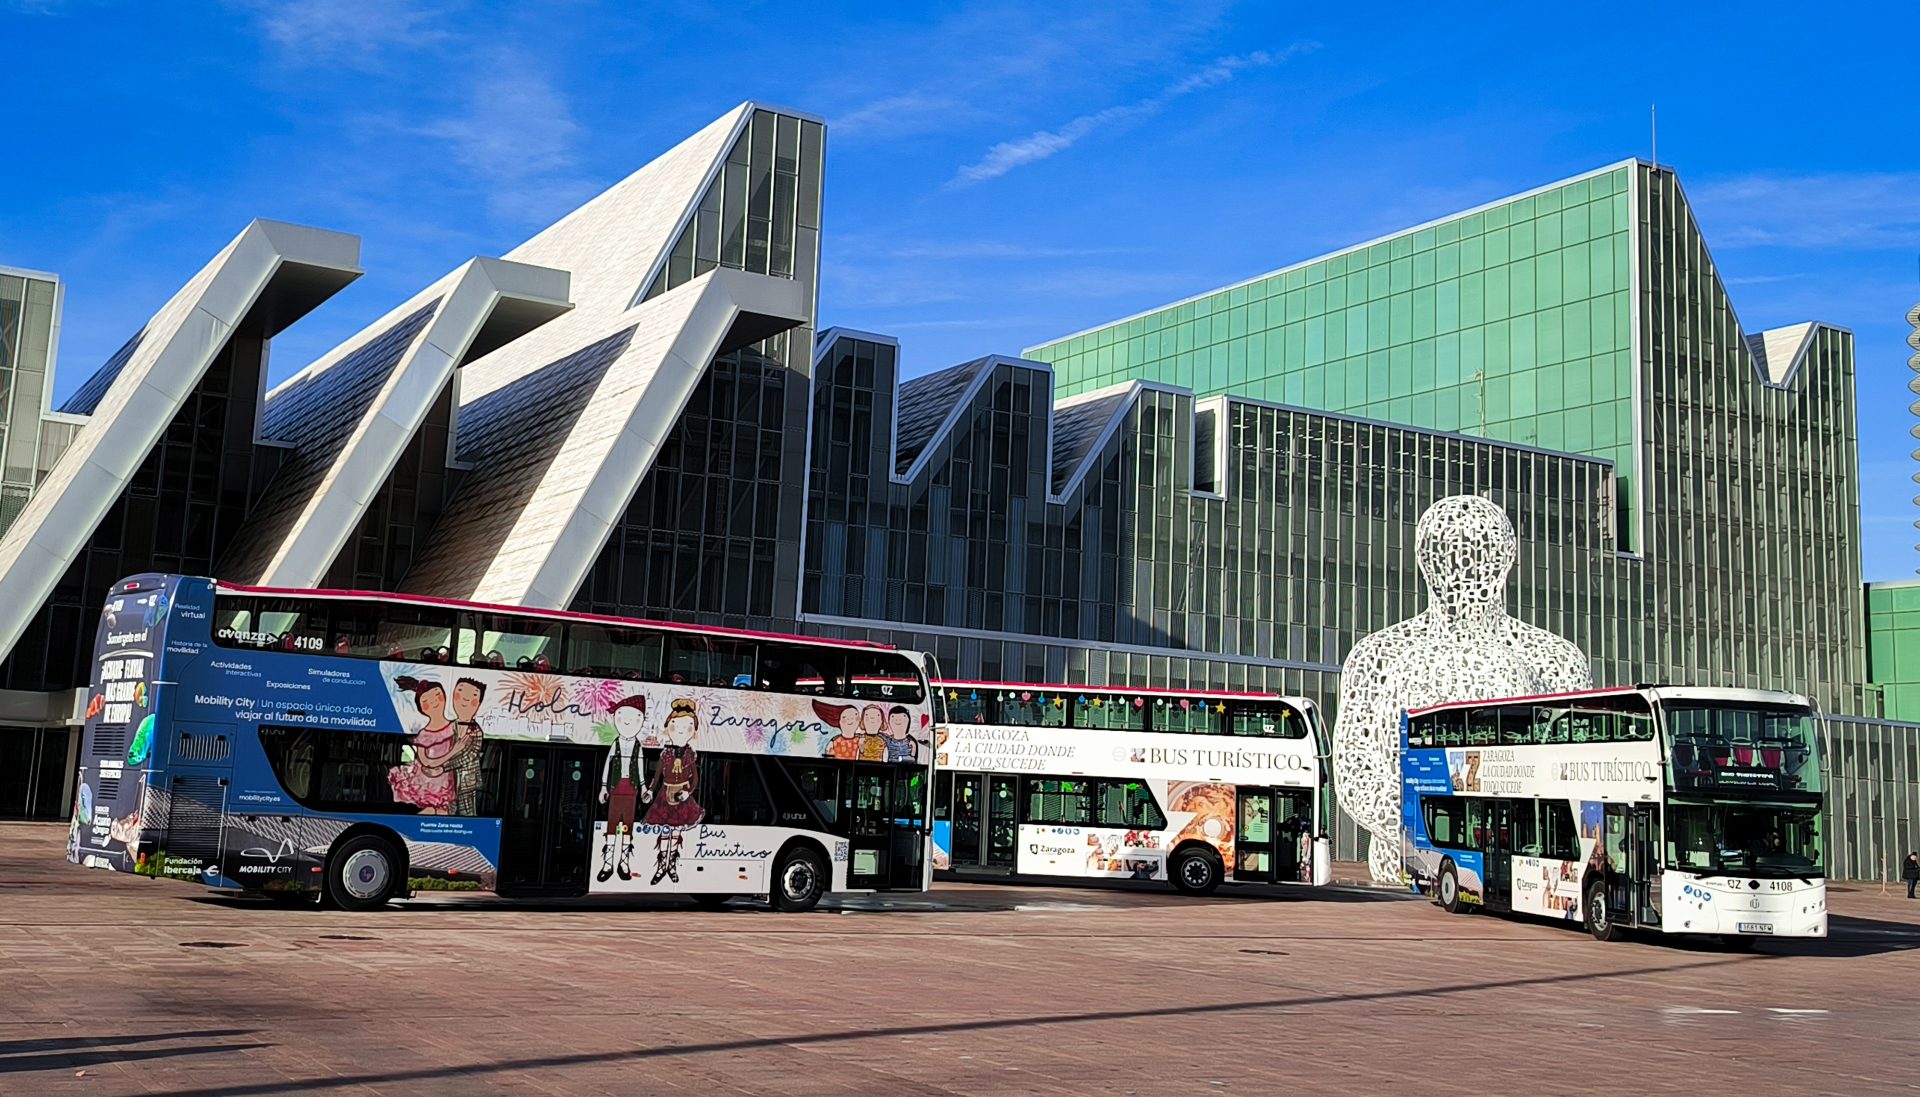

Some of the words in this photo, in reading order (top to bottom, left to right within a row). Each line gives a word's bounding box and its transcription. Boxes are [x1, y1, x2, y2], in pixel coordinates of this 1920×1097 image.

[180, 611, 206, 619] virtual
[172, 640, 194, 648] Historia
[218, 629, 266, 641] avanza
[294, 636, 324, 650] 4109
[166, 646, 199, 654] movilidad
[210, 660, 252, 670] Actividades
[308, 668, 350, 678] Simuladores
[266, 680, 311, 691] Exposiciones
[194, 694, 234, 708] Mobility
[235, 697, 256, 711] City
[260, 699, 274, 709] Un
[275, 701, 314, 714] espacio
[315, 702, 341, 712] único
[342, 706, 373, 716] donde
[235, 710, 262, 722] viajar
[264, 712, 274, 721] al
[275, 712, 304, 722] futuro
[306, 714, 318, 724] de
[320, 715, 329, 724] la
[330, 716, 376, 727] movilidad
[508, 687, 591, 716] Hola
[709, 706, 829, 749] Zaragoza
[955, 728, 1030, 742] ZARAGOZA
[954, 742, 972, 753] LA
[974, 742, 1026, 756] CIUDAD
[1027, 744, 1076, 758] DONDE
[1482, 750, 1515, 762] ZARAGOZA
[956, 756, 993, 768] TODO
[994, 758, 1047, 771] SUCEDE
[1150, 748, 1188, 766] BUS
[1193, 748, 1302, 771] TURÍSTICO
[1514, 765, 1536, 778] DONDE
[1569, 762, 1590, 782] BUS
[1592, 757, 1652, 782] TURÍSTICO
[700, 824, 727, 839] Bus
[1040, 845, 1076, 856] Zaragoza
[164, 857, 203, 865] Fundación
[163, 866, 202, 876] Ibercaja
[238, 865, 276, 874] MOBILITY
[276, 866, 293, 874] CITY
[1769, 881, 1793, 892] 4108
